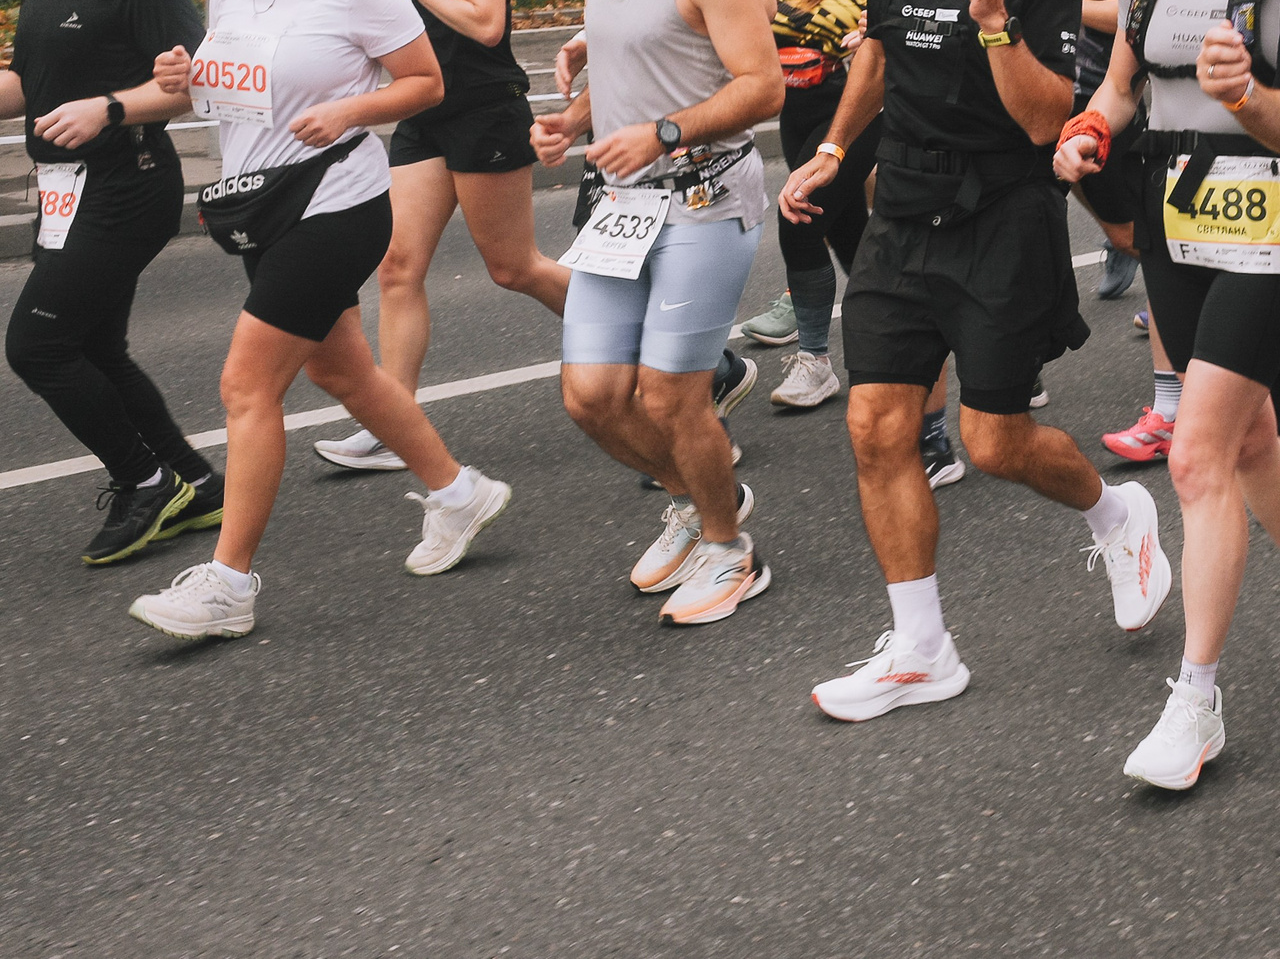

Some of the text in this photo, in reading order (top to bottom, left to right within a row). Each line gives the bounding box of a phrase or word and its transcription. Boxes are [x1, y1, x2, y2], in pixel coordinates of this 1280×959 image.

[912, 8, 935, 18] СБЕР
[905, 30, 944, 43] HUAWEI
[1172, 33, 1206, 43] HUAW
[190, 58, 267, 93] 20520
[204, 99, 211, 114] J
[202, 174, 266, 203] adidas
[592, 212, 654, 240] 4533
[1196, 224, 1248, 236] СВЕТЛАНА
[1179, 243, 1190, 260] F
